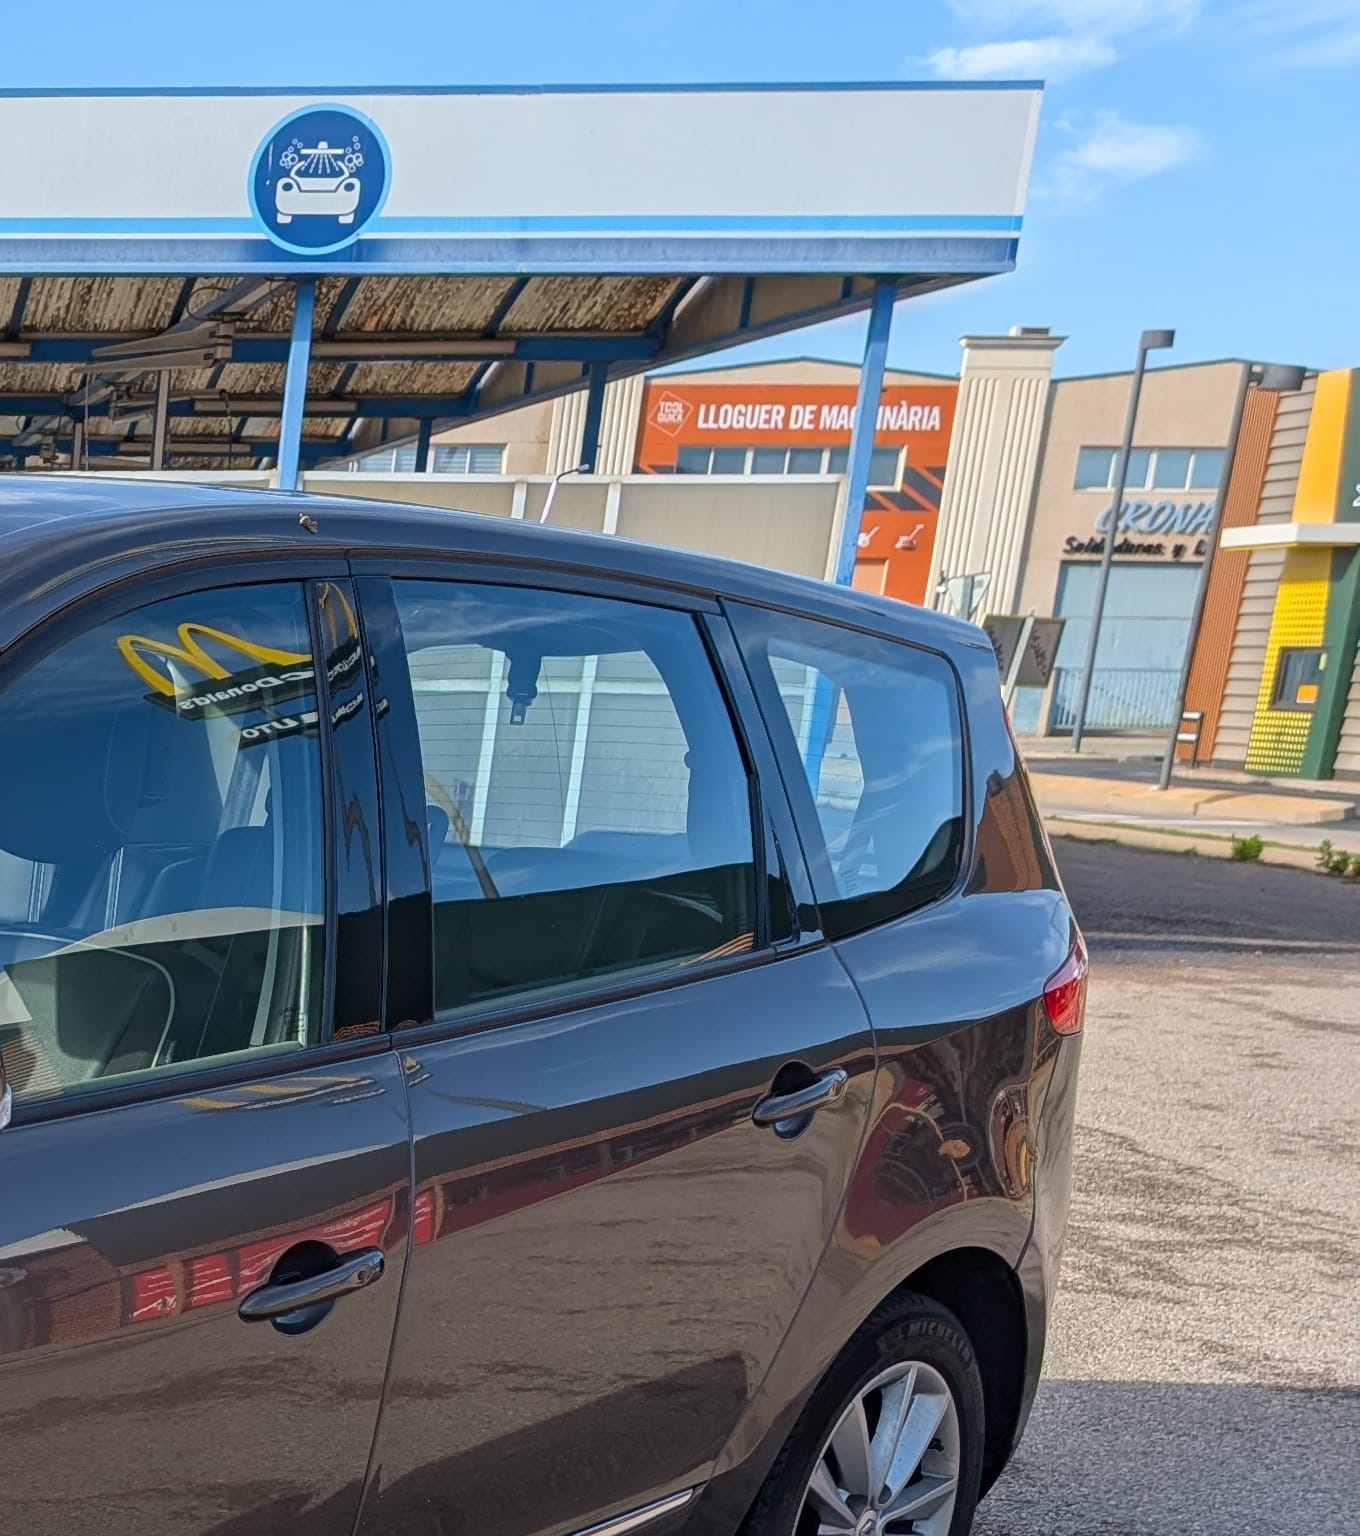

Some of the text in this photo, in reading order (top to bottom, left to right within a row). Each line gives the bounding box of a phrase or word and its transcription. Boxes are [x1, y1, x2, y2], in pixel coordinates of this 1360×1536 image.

[697, 404, 785, 430] LLOGUER
[788, 404, 818, 430] DE
[1062, 535, 1164, 556] Soldduras
